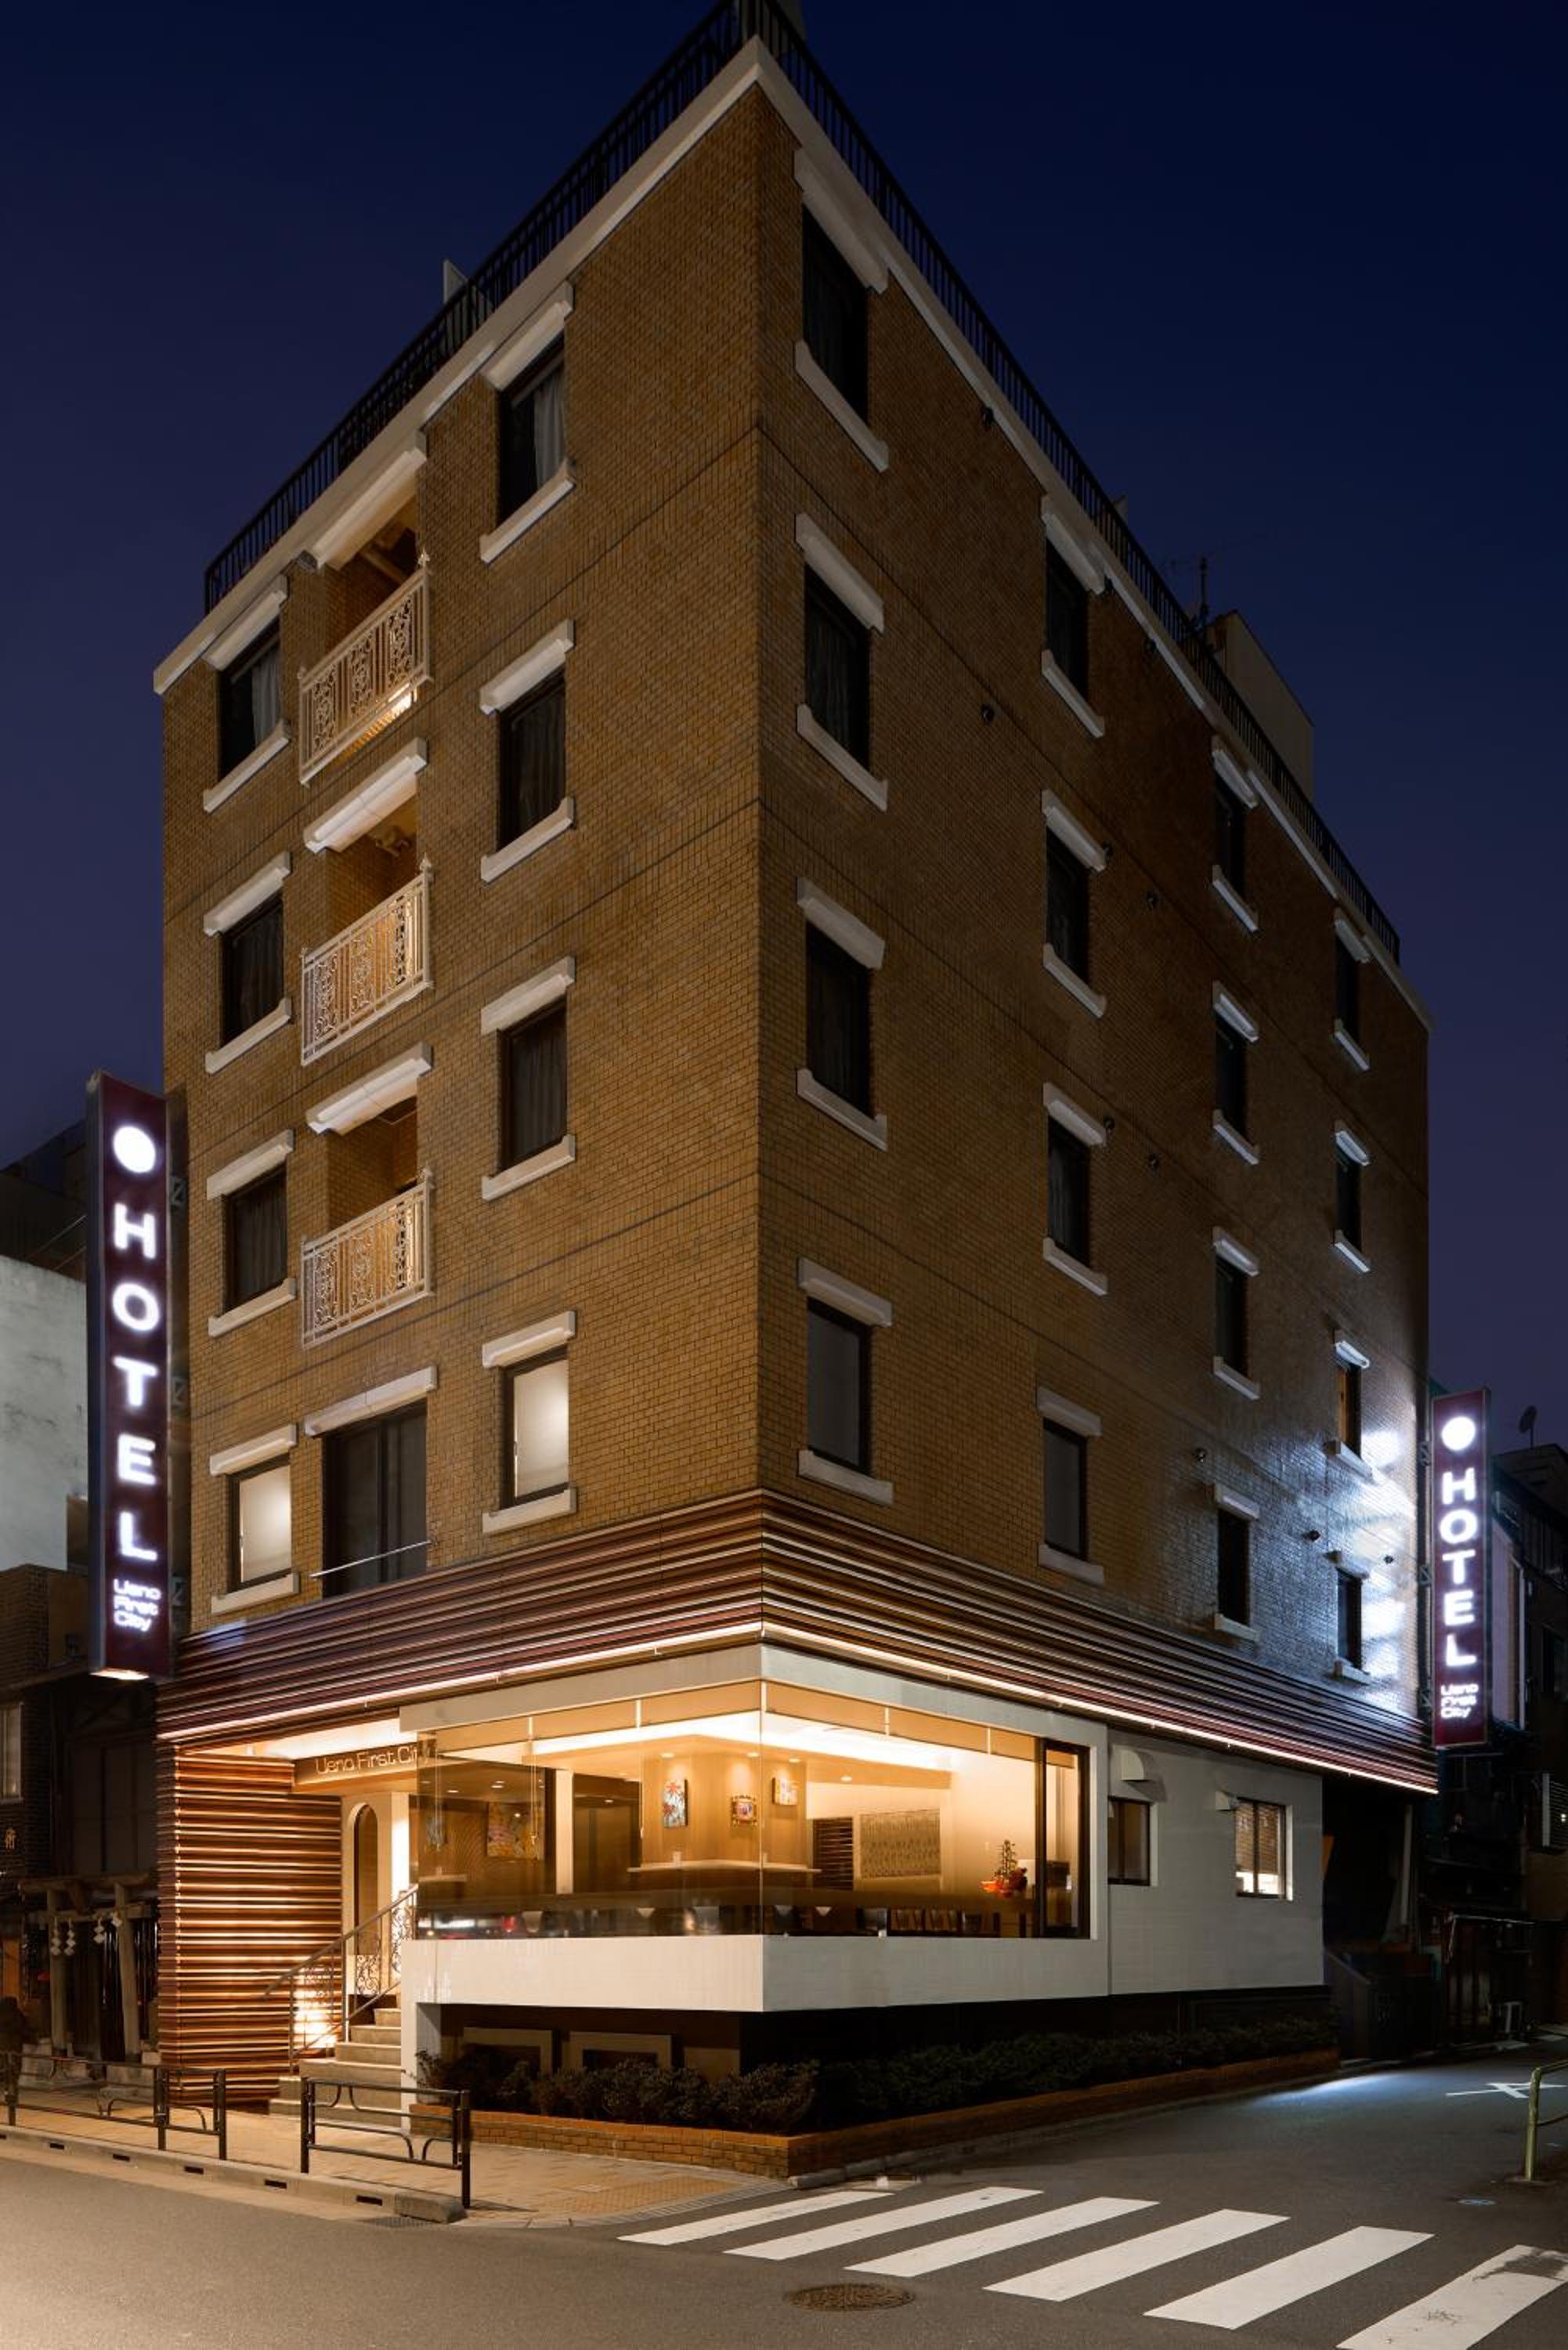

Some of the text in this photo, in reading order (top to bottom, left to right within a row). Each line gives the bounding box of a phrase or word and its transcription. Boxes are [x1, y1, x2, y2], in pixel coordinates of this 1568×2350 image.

[111, 1202, 161, 1561] HOTEL
[1439, 1467, 1479, 1667] HOTEL
[114, 1610, 152, 1632] City
[1440, 1707, 1472, 1719] City
[315, 1757, 355, 1775] Ueno
[357, 1752, 394, 1770] First
